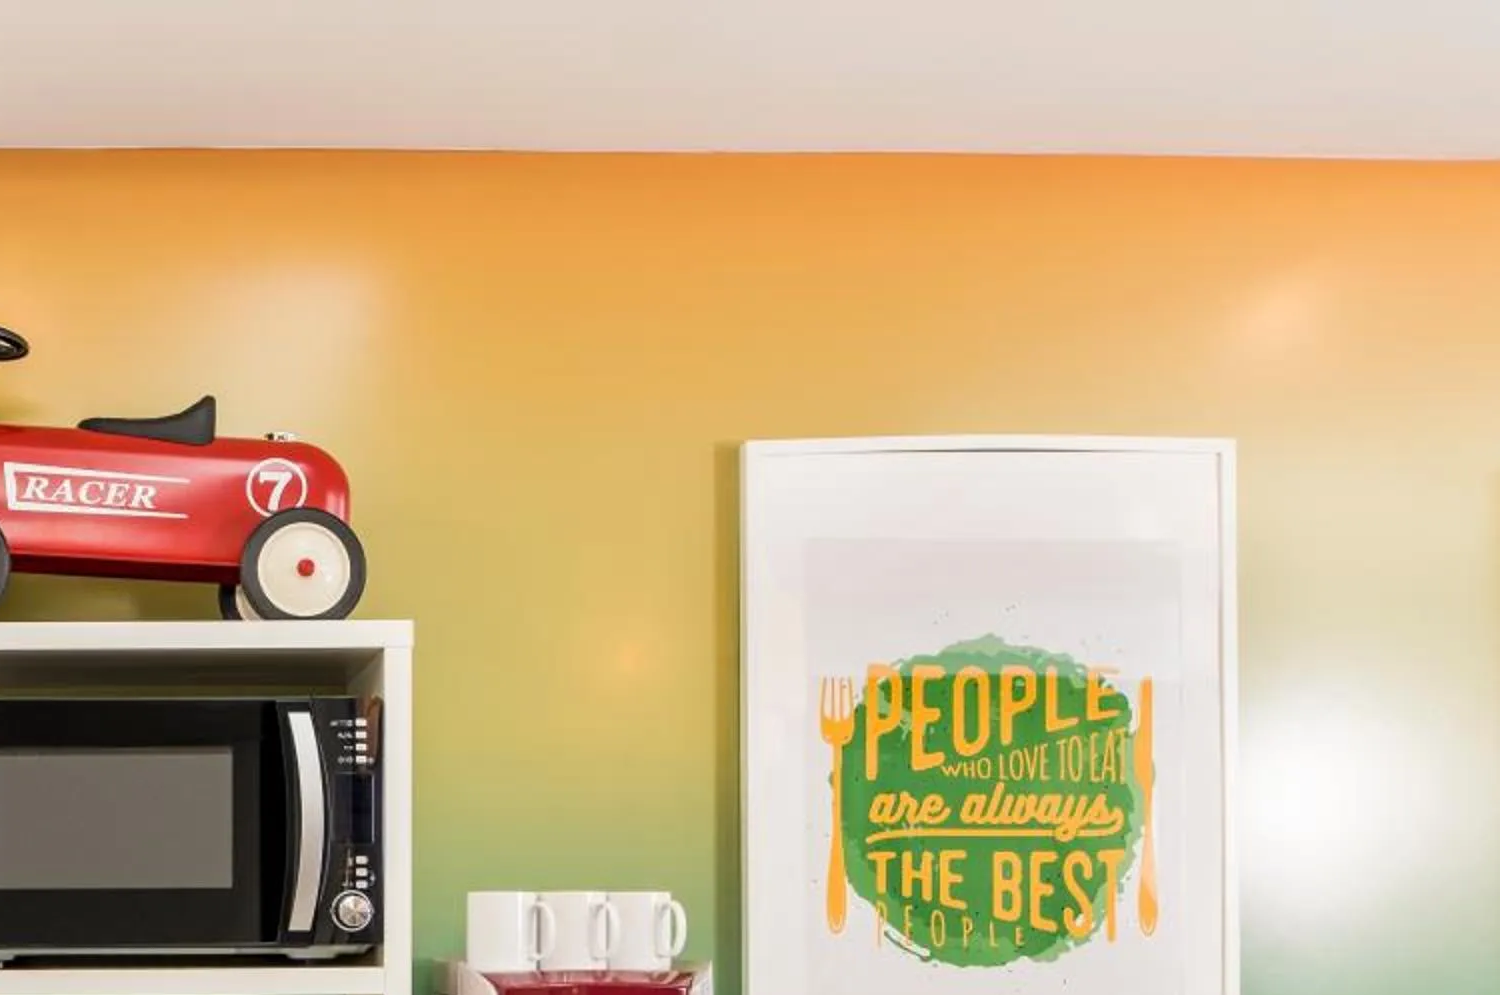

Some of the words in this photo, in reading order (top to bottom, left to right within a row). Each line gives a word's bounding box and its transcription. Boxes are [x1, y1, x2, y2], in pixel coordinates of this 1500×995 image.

[24, 475, 157, 510] RACER
[259, 471, 293, 512] 7
[864, 664, 1122, 780] PEOPLE
[941, 758, 991, 780] WHO
[999, 744, 1051, 782] LOVE
[1056, 735, 1083, 784] TO
[1088, 728, 1126, 785] EAT
[867, 791, 952, 824] are
[960, 783, 1125, 842] always
[867, 850, 968, 911] THE
[992, 849, 1126, 943] BEST
[874, 900, 1026, 948] PEOPLE
